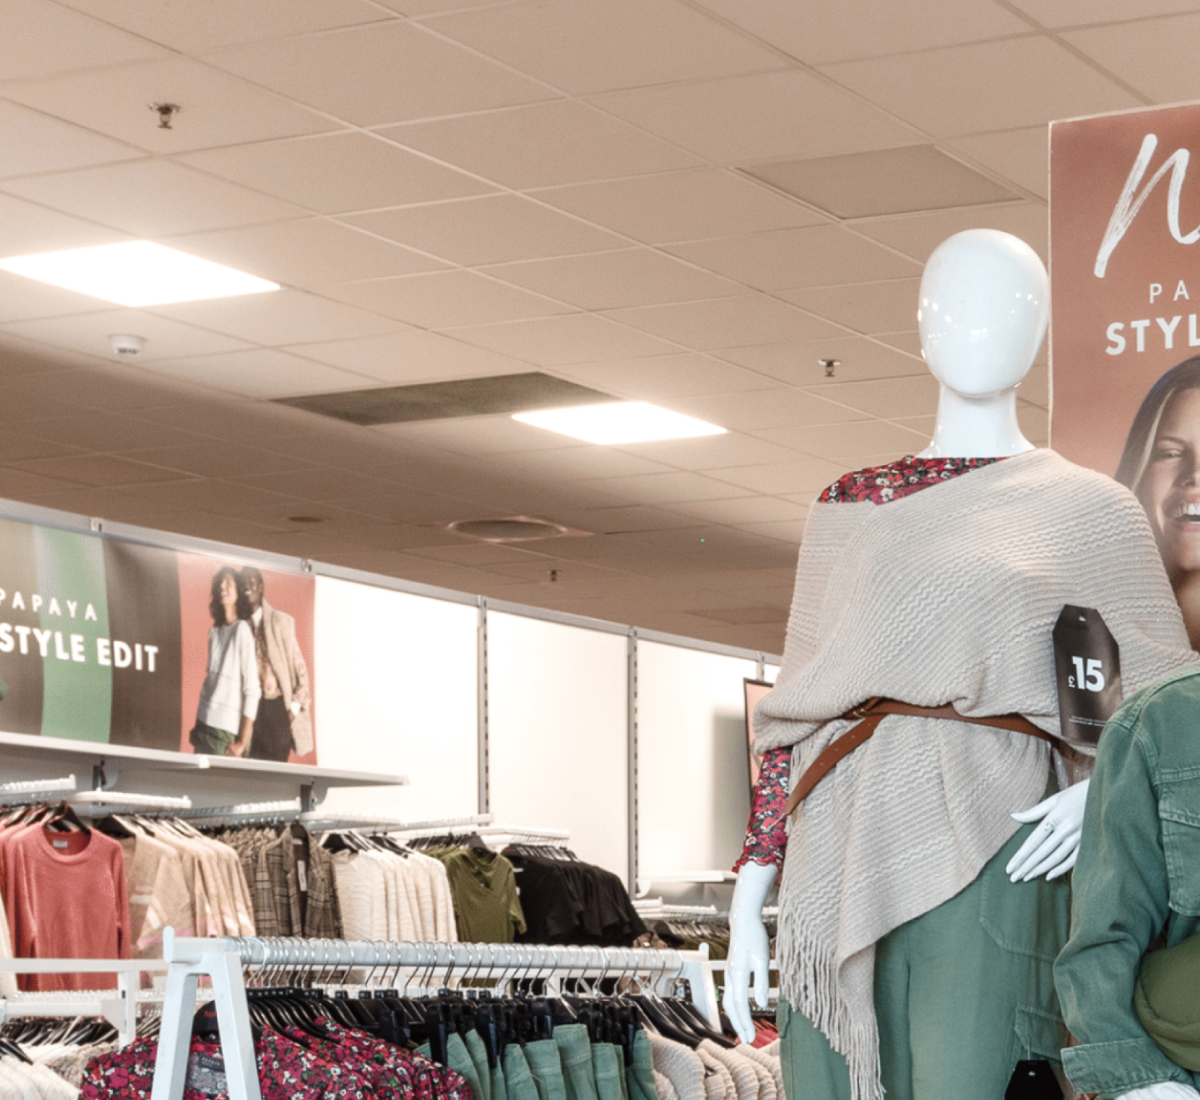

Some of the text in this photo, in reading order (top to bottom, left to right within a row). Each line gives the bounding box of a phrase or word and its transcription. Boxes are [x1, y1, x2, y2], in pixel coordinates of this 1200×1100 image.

[0, 622, 159, 672] STYLE EDIT
[1068, 656, 1105, 692] £15
